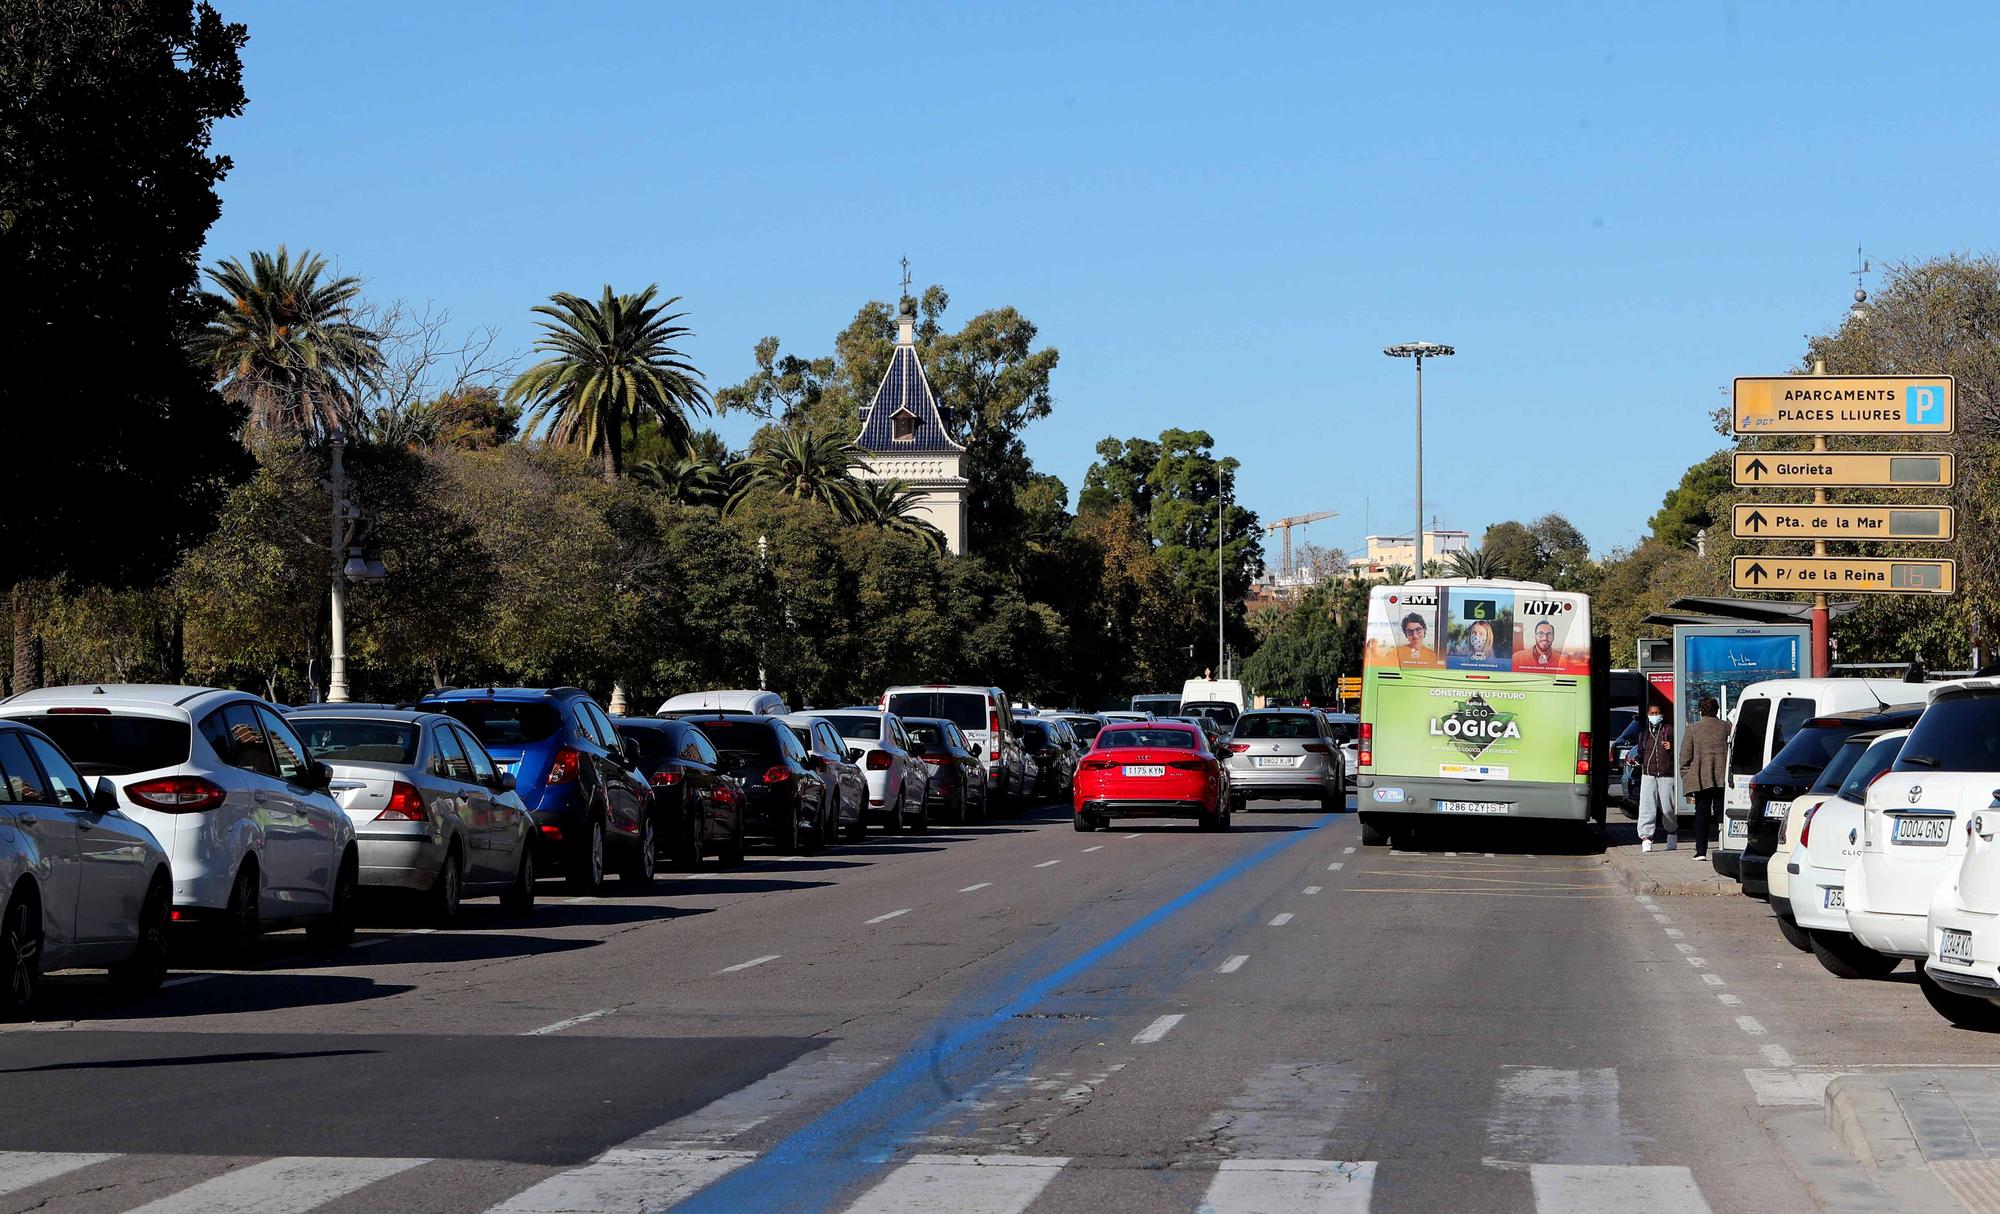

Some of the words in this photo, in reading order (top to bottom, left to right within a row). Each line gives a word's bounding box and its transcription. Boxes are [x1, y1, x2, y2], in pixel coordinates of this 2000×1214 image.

[1784, 390, 1896, 401] APARCAMENTS
[1916, 389, 1934, 422] P
[1778, 410, 1834, 420] PLACES
[1841, 410, 1901, 421] LLIURES
[1776, 464, 1833, 475] Glorieta
[1776, 516, 1804, 528] Pta.
[1812, 517, 1828, 528] de
[1836, 517, 1849, 528] la
[1857, 517, 1883, 529] Mar
[1776, 568, 1792, 580] P/
[1798, 569, 1816, 580] de
[1823, 569, 1837, 580] la
[1844, 569, 1885, 581] Reina
[1402, 595, 1438, 605] EMT
[1474, 602, 1486, 618] 6
[1524, 601, 1563, 616] 7072
[1429, 688, 1478, 698] CONSTRUYE
[1492, 691, 1525, 700] FUTURO
[1465, 708, 1488, 717] ECO
[1430, 714, 1521, 739] LÓGICA
[1128, 766, 1147, 774] 1175
[1148, 767, 1164, 775] KYN
[1444, 801, 1466, 811] 1286
[1468, 802, 1485, 812] CZY
[1900, 819, 1924, 838] 0004
[1925, 820, 1945, 839] GNS
